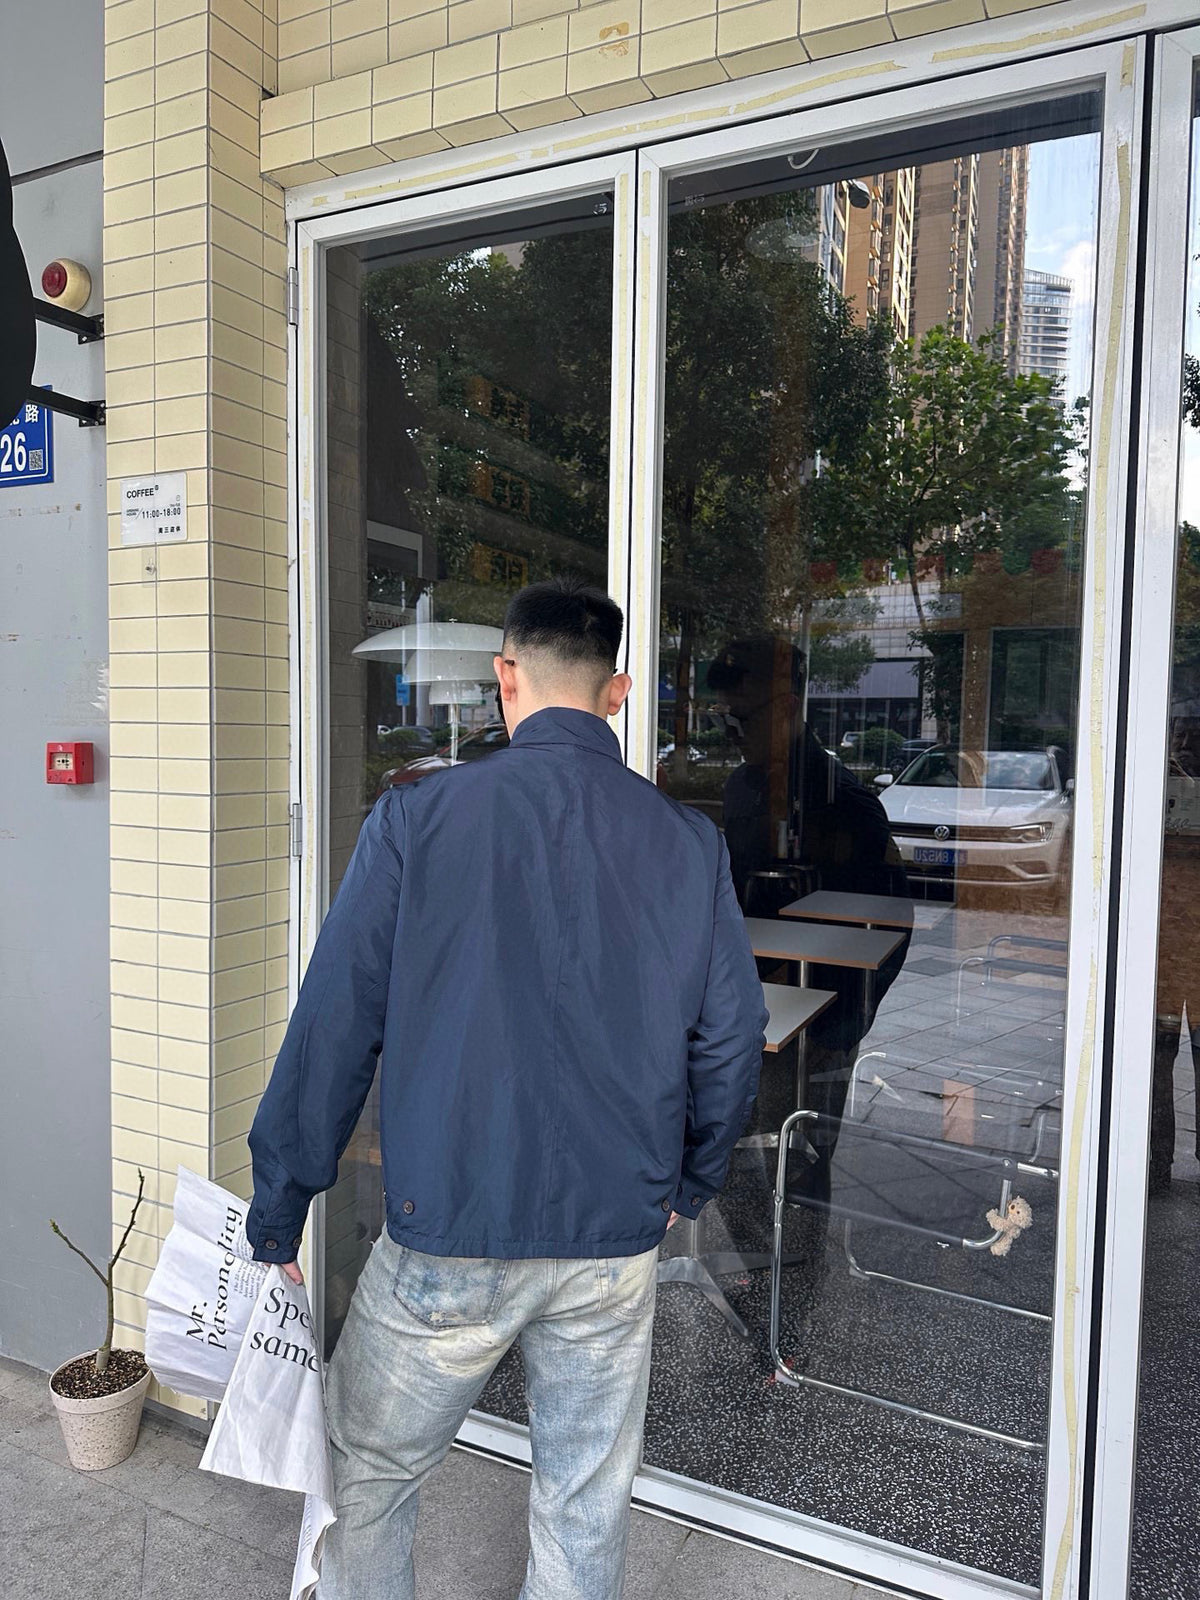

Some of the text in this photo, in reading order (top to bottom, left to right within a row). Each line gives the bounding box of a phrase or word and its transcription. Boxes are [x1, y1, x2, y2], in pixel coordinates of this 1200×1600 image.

[0, 432, 27, 473] 26
[142, 507, 181, 519] 11:00-18:00
[186, 1301, 207, 1343] Mr.
